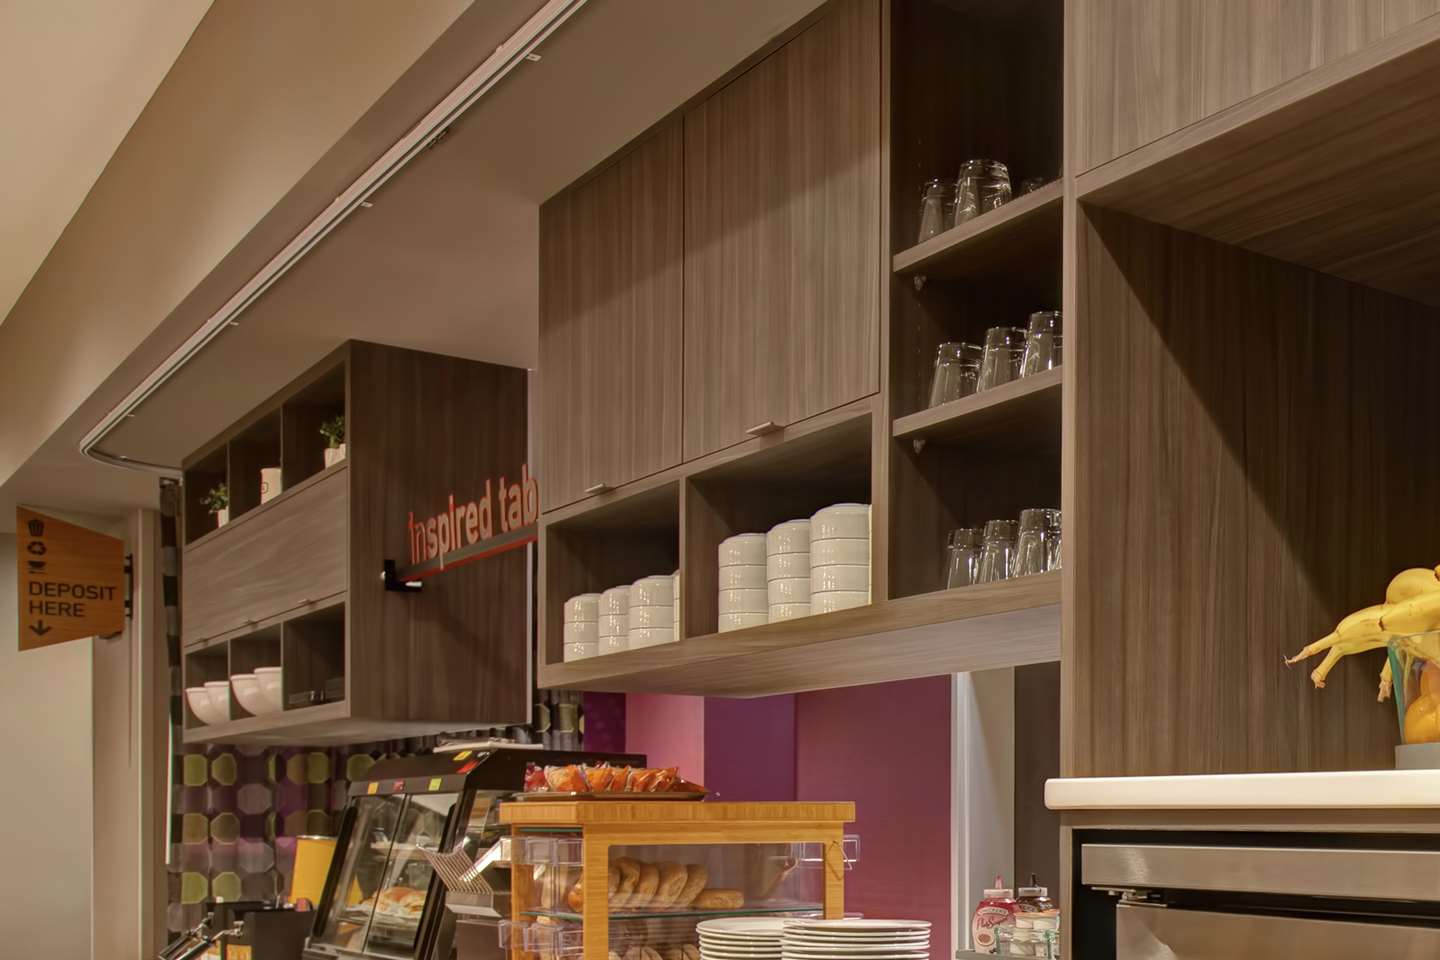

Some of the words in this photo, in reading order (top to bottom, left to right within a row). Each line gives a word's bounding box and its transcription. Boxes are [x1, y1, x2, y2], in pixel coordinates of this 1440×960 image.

[408, 479, 492, 571] inspired
[499, 463, 541, 528] tab
[29, 581, 117, 601] DEPOSIT
[29, 601, 87, 618] HERE
